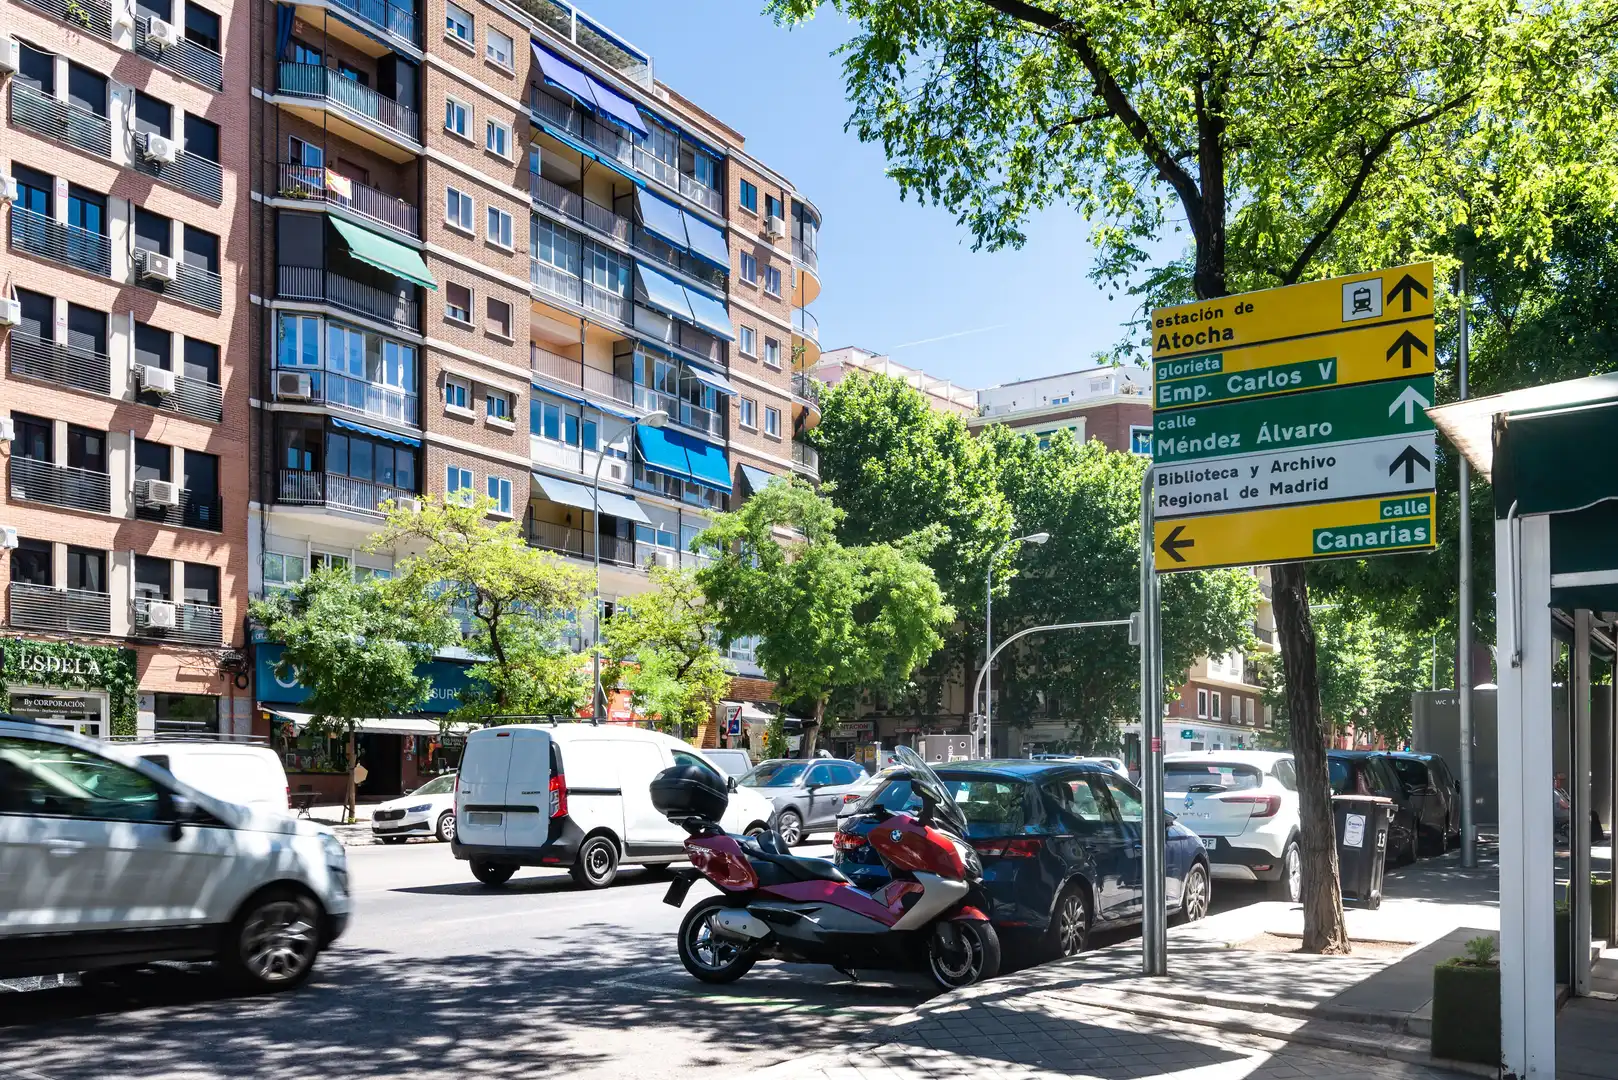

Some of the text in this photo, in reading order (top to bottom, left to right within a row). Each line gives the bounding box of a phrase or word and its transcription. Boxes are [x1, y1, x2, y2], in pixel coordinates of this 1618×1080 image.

[1155, 301, 1254, 329] estación de
[1156, 326, 1234, 352] Atocha
[1158, 357, 1220, 380] glorieta
[1159, 361, 1333, 403] Emp. Carlos V
[1157, 415, 1197, 431] calle
[1157, 421, 1333, 457] Méndez Álvaro
[1158, 455, 1337, 487] Biblioteca y Archivo
[1158, 476, 1329, 508] Regional de Madrid
[1382, 500, 1428, 517] calle
[1316, 524, 1427, 550] Canarias
[20, 653, 102, 676] ESDELA
[33, 699, 86, 708] CORPORACIÓN
